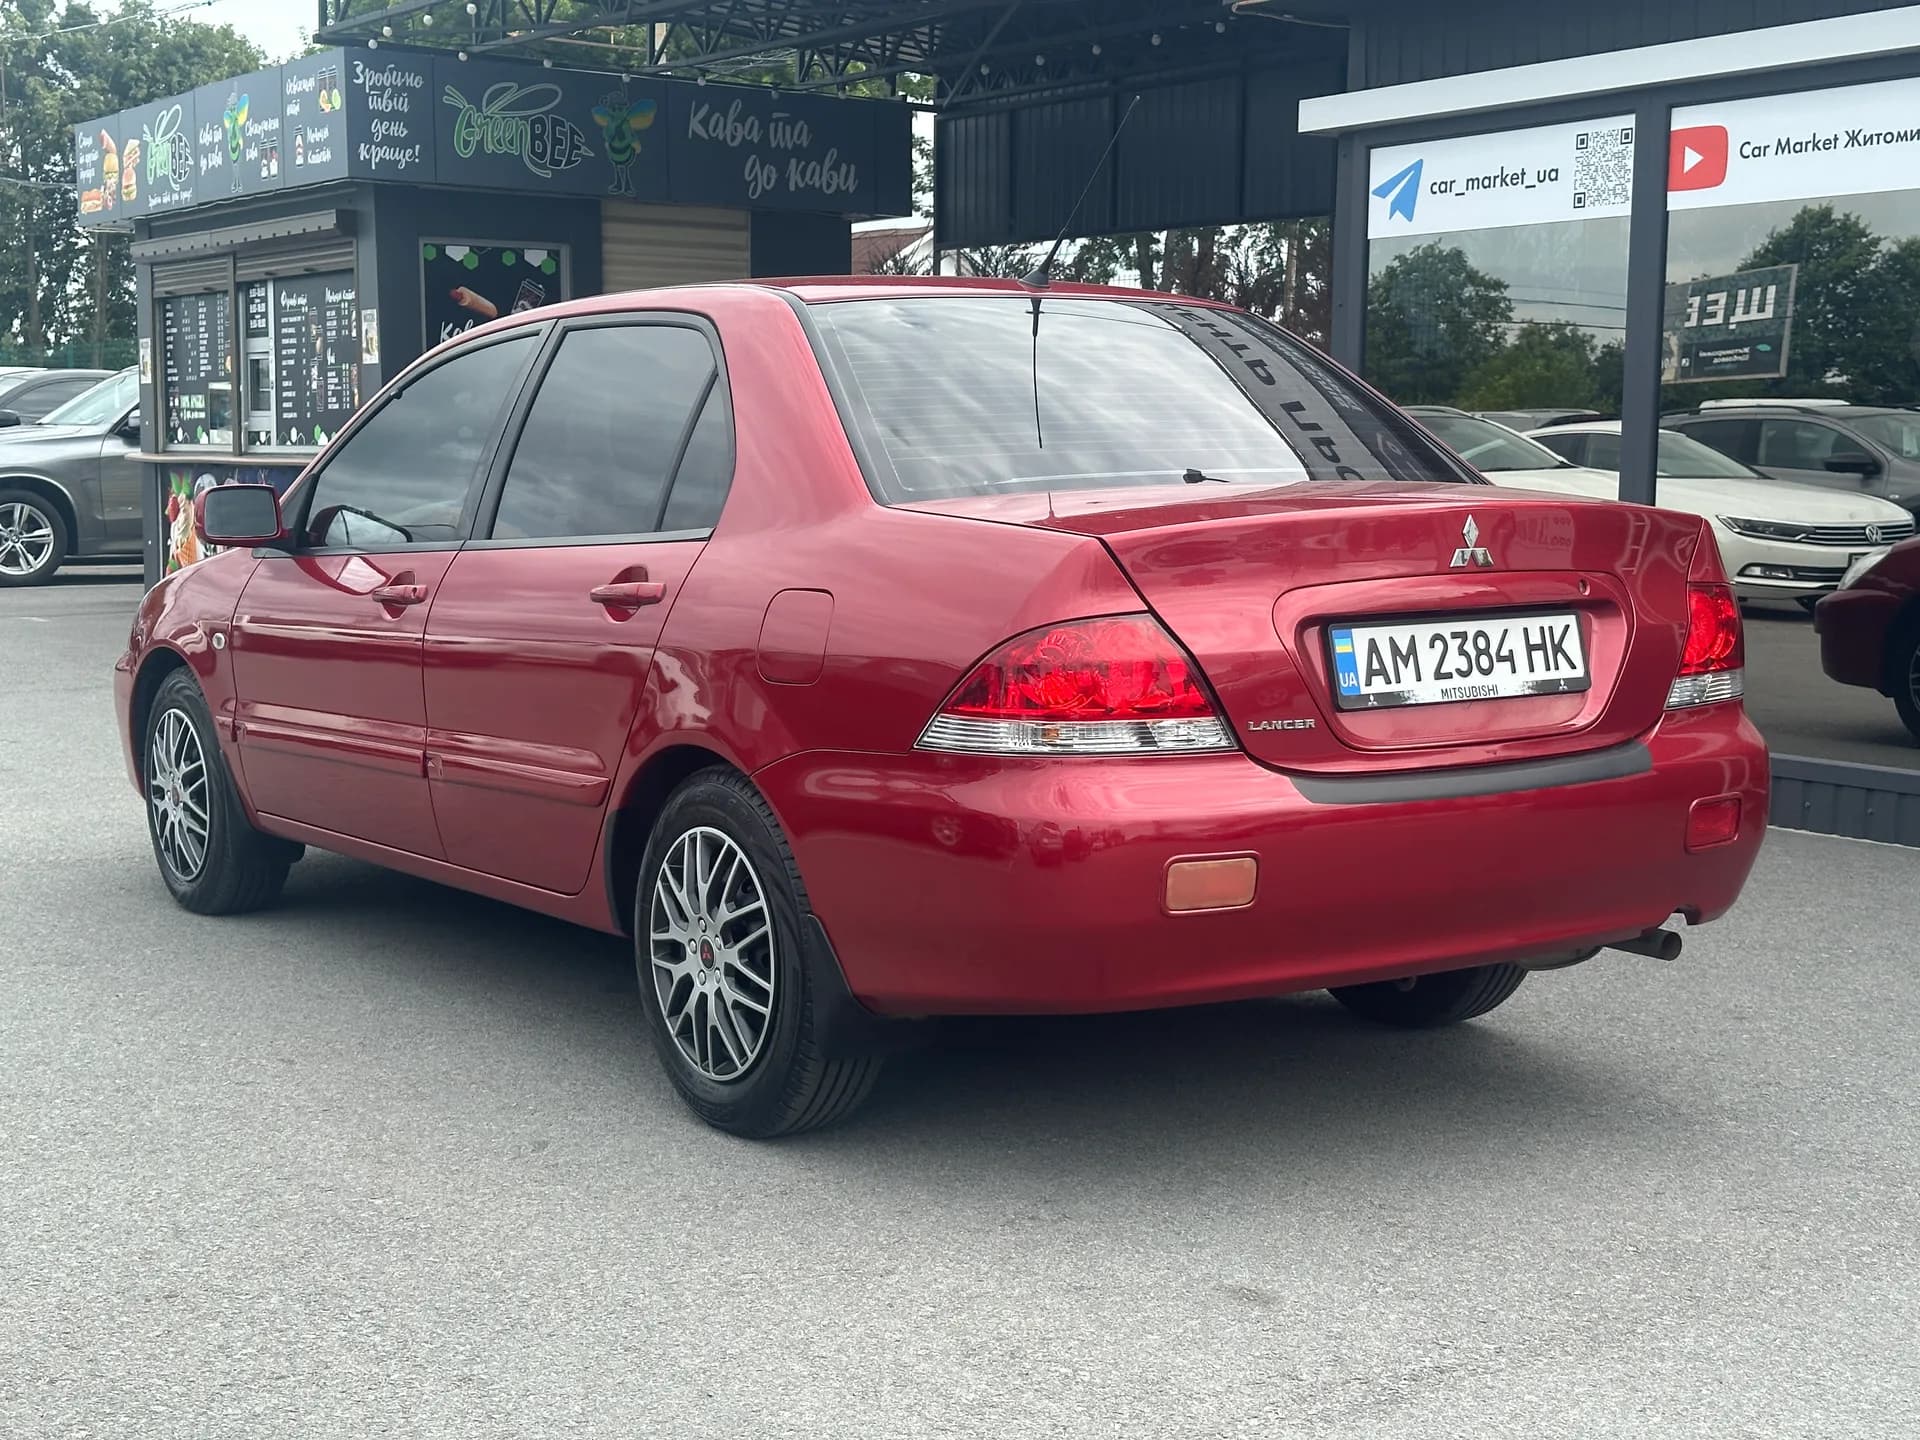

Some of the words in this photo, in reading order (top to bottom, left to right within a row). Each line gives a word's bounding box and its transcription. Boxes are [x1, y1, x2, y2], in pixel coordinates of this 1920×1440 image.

[353, 60, 424, 93] Зробимо
[368, 88, 409, 112] твій
[371, 119, 408, 142] день
[688, 98, 763, 147] Кава
[769, 112, 812, 149] та
[358, 142, 420, 170] краще!
[1739, 141, 1770, 159] Car
[1775, 132, 1839, 156] Market
[744, 155, 778, 199] до
[786, 148, 858, 194] кави
[1430, 166, 1559, 197] car_market_ua
[1365, 634, 1422, 687] AM
[1429, 629, 1516, 681] 2384
[1523, 624, 1577, 673] HK
[1339, 673, 1359, 688] UA
[1441, 684, 1499, 700] MITSUBISHI
[1247, 718, 1317, 731] LANCER
